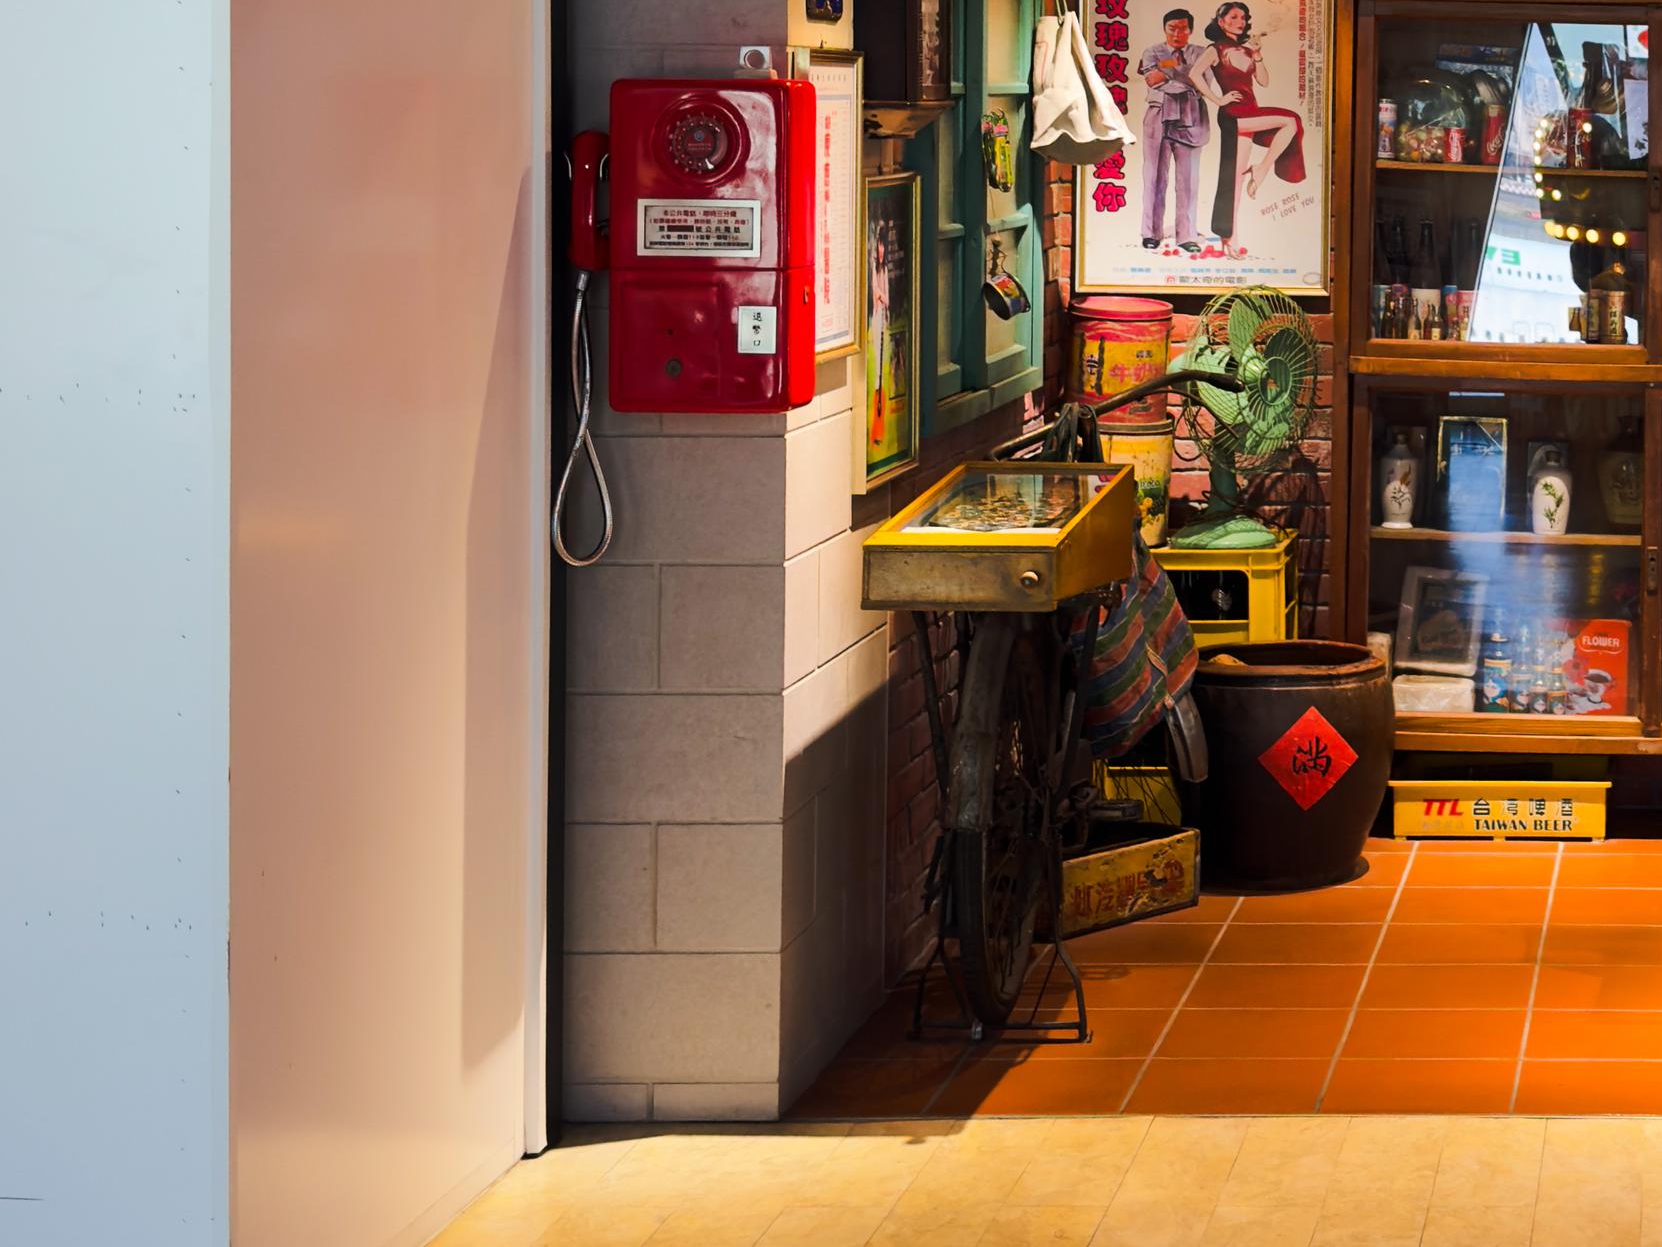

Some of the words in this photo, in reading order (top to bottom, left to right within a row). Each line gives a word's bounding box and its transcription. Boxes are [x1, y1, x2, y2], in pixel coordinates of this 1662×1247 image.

[1582, 635, 1620, 648] FLOWER
[1423, 798, 1464, 816] TTL
[1473, 819, 1528, 832] TAIWAN
[1533, 819, 1572, 832] BEER
